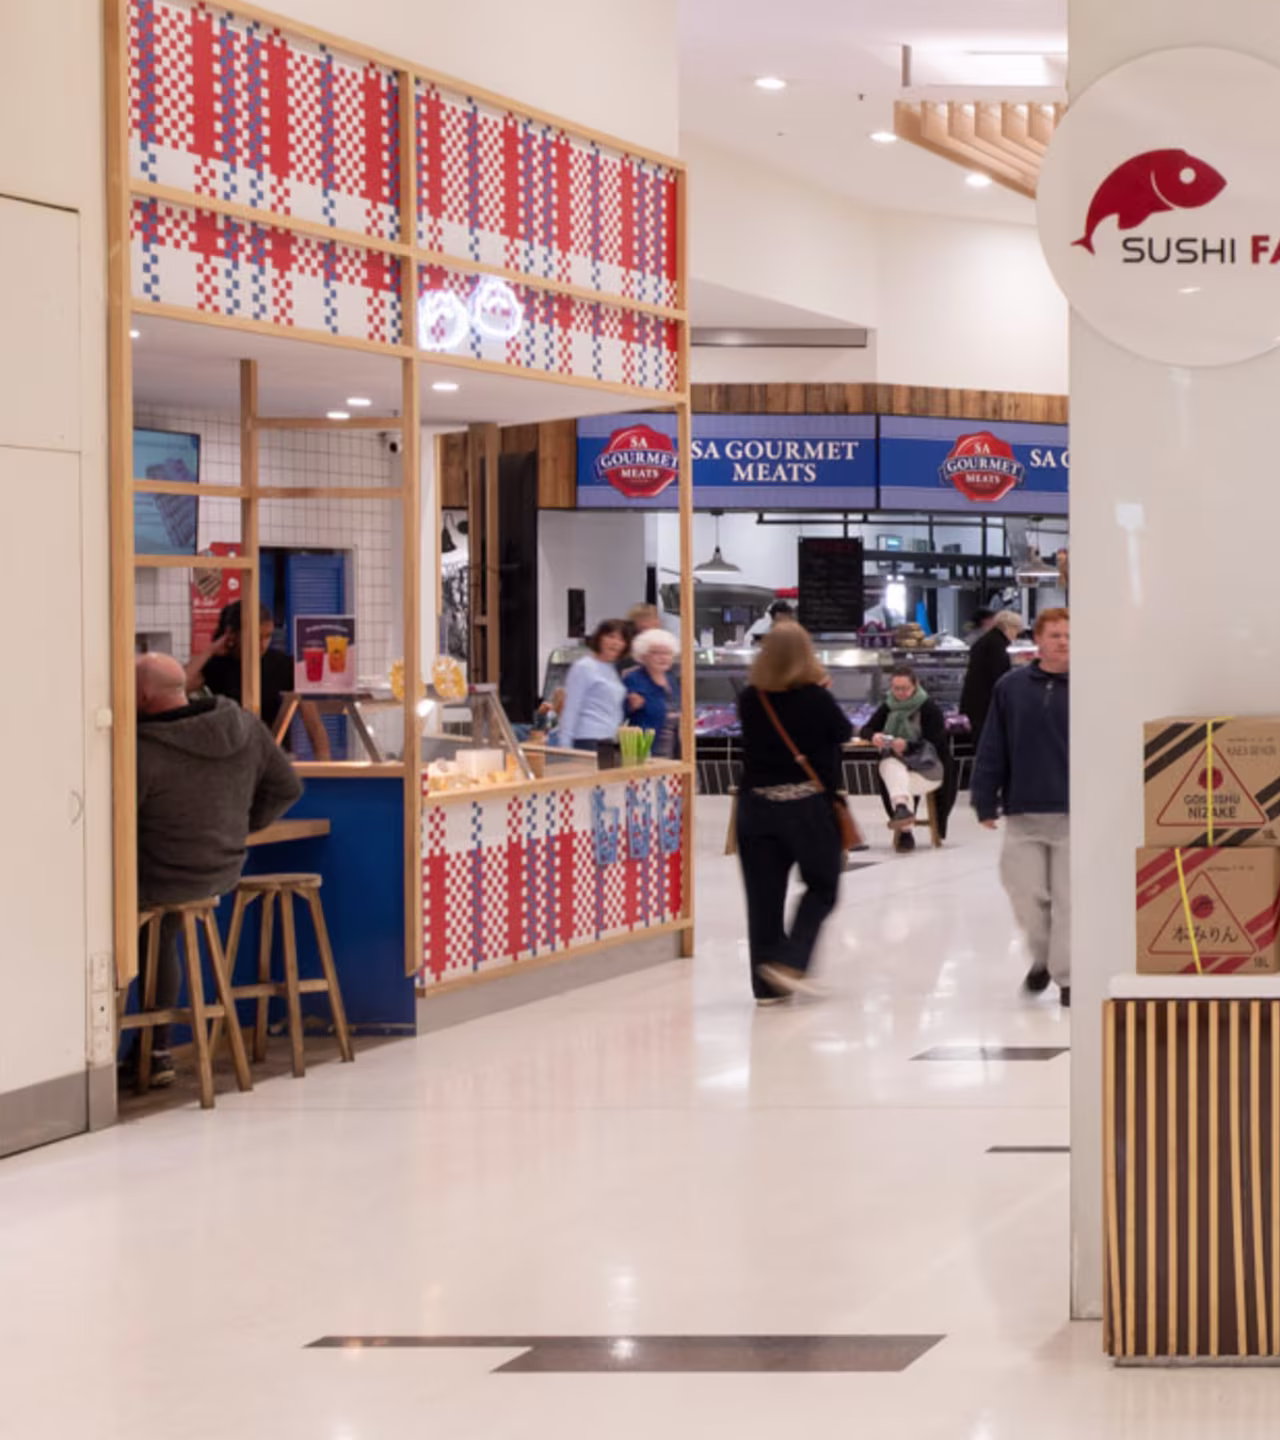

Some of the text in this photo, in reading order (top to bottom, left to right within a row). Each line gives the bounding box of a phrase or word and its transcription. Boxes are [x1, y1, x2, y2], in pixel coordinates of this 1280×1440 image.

[1121, 237, 1236, 264] SUSHI
[630, 436, 648, 448] SA
[691, 441, 859, 460] SA GOURMET
[974, 443, 991, 454] SA
[600, 450, 679, 468] GOURMET
[947, 457, 1020, 475] GOURMET
[1030, 449, 1057, 468] SA
[621, 467, 659, 479] MEATS
[733, 463, 818, 482] MEATS
[966, 473, 1001, 484] MEATS
